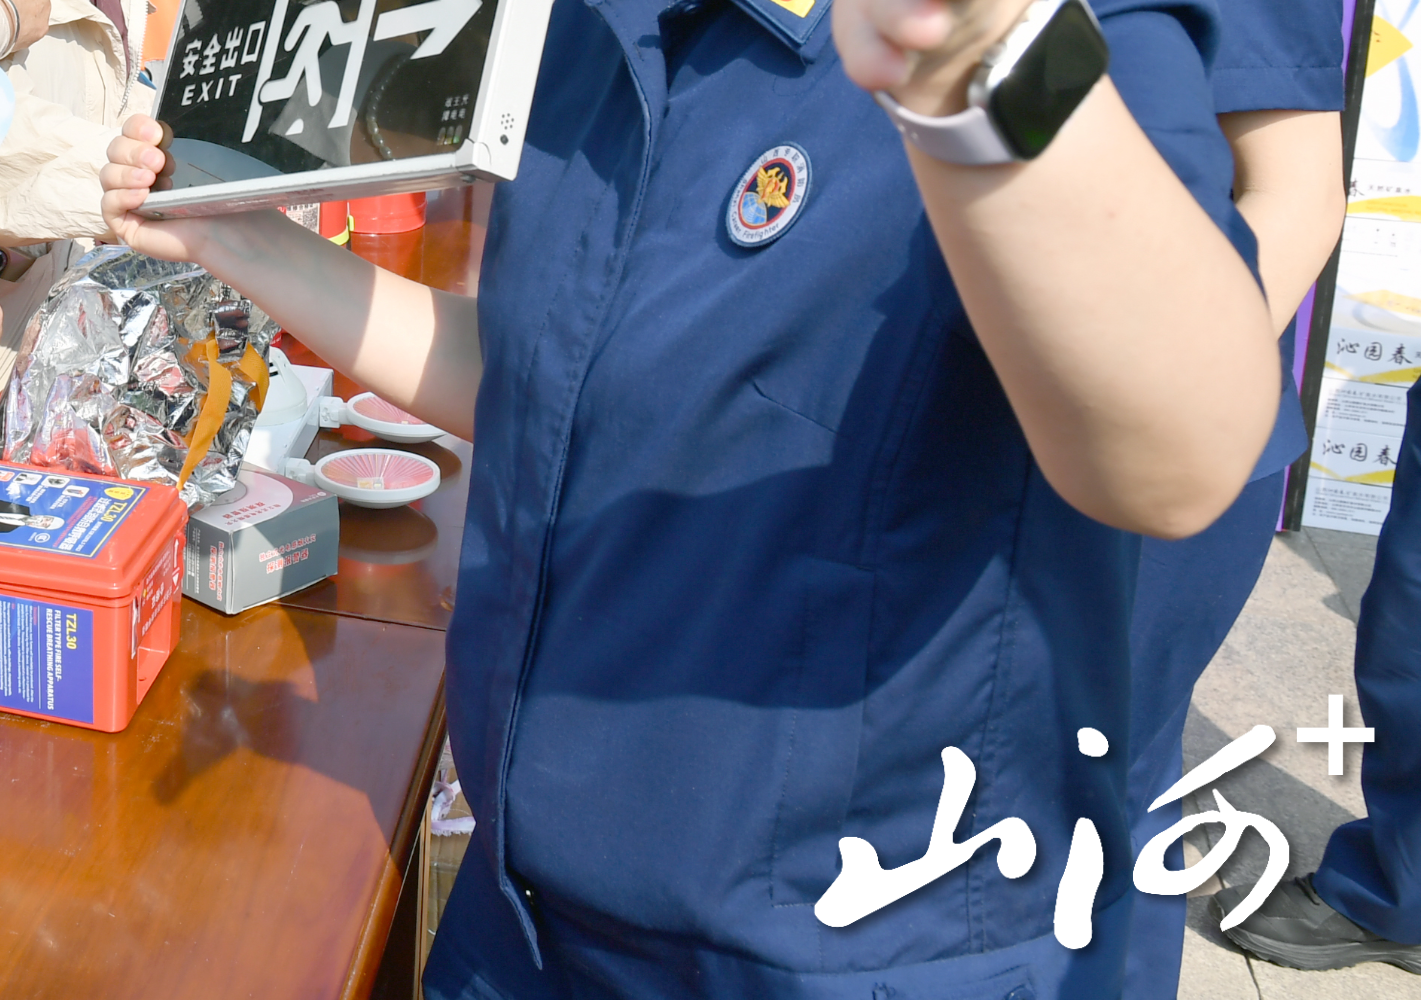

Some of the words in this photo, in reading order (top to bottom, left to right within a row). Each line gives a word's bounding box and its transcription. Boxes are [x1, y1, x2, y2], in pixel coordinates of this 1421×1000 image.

[180, 20, 266, 79] 安全出口
[181, 74, 242, 106] EXIT
[1336, 338, 1413, 366] 沁园春
[1322, 439, 1398, 466] 沁园春
[45, 607, 53, 634] RESCUE
[53, 608, 61, 632] FILTER
[65, 611, 77, 650] TZL30
[45, 633, 53, 672] BREATHING
[54, 662, 62, 682] SELF-
[46, 671, 54, 710] APPARATUS
